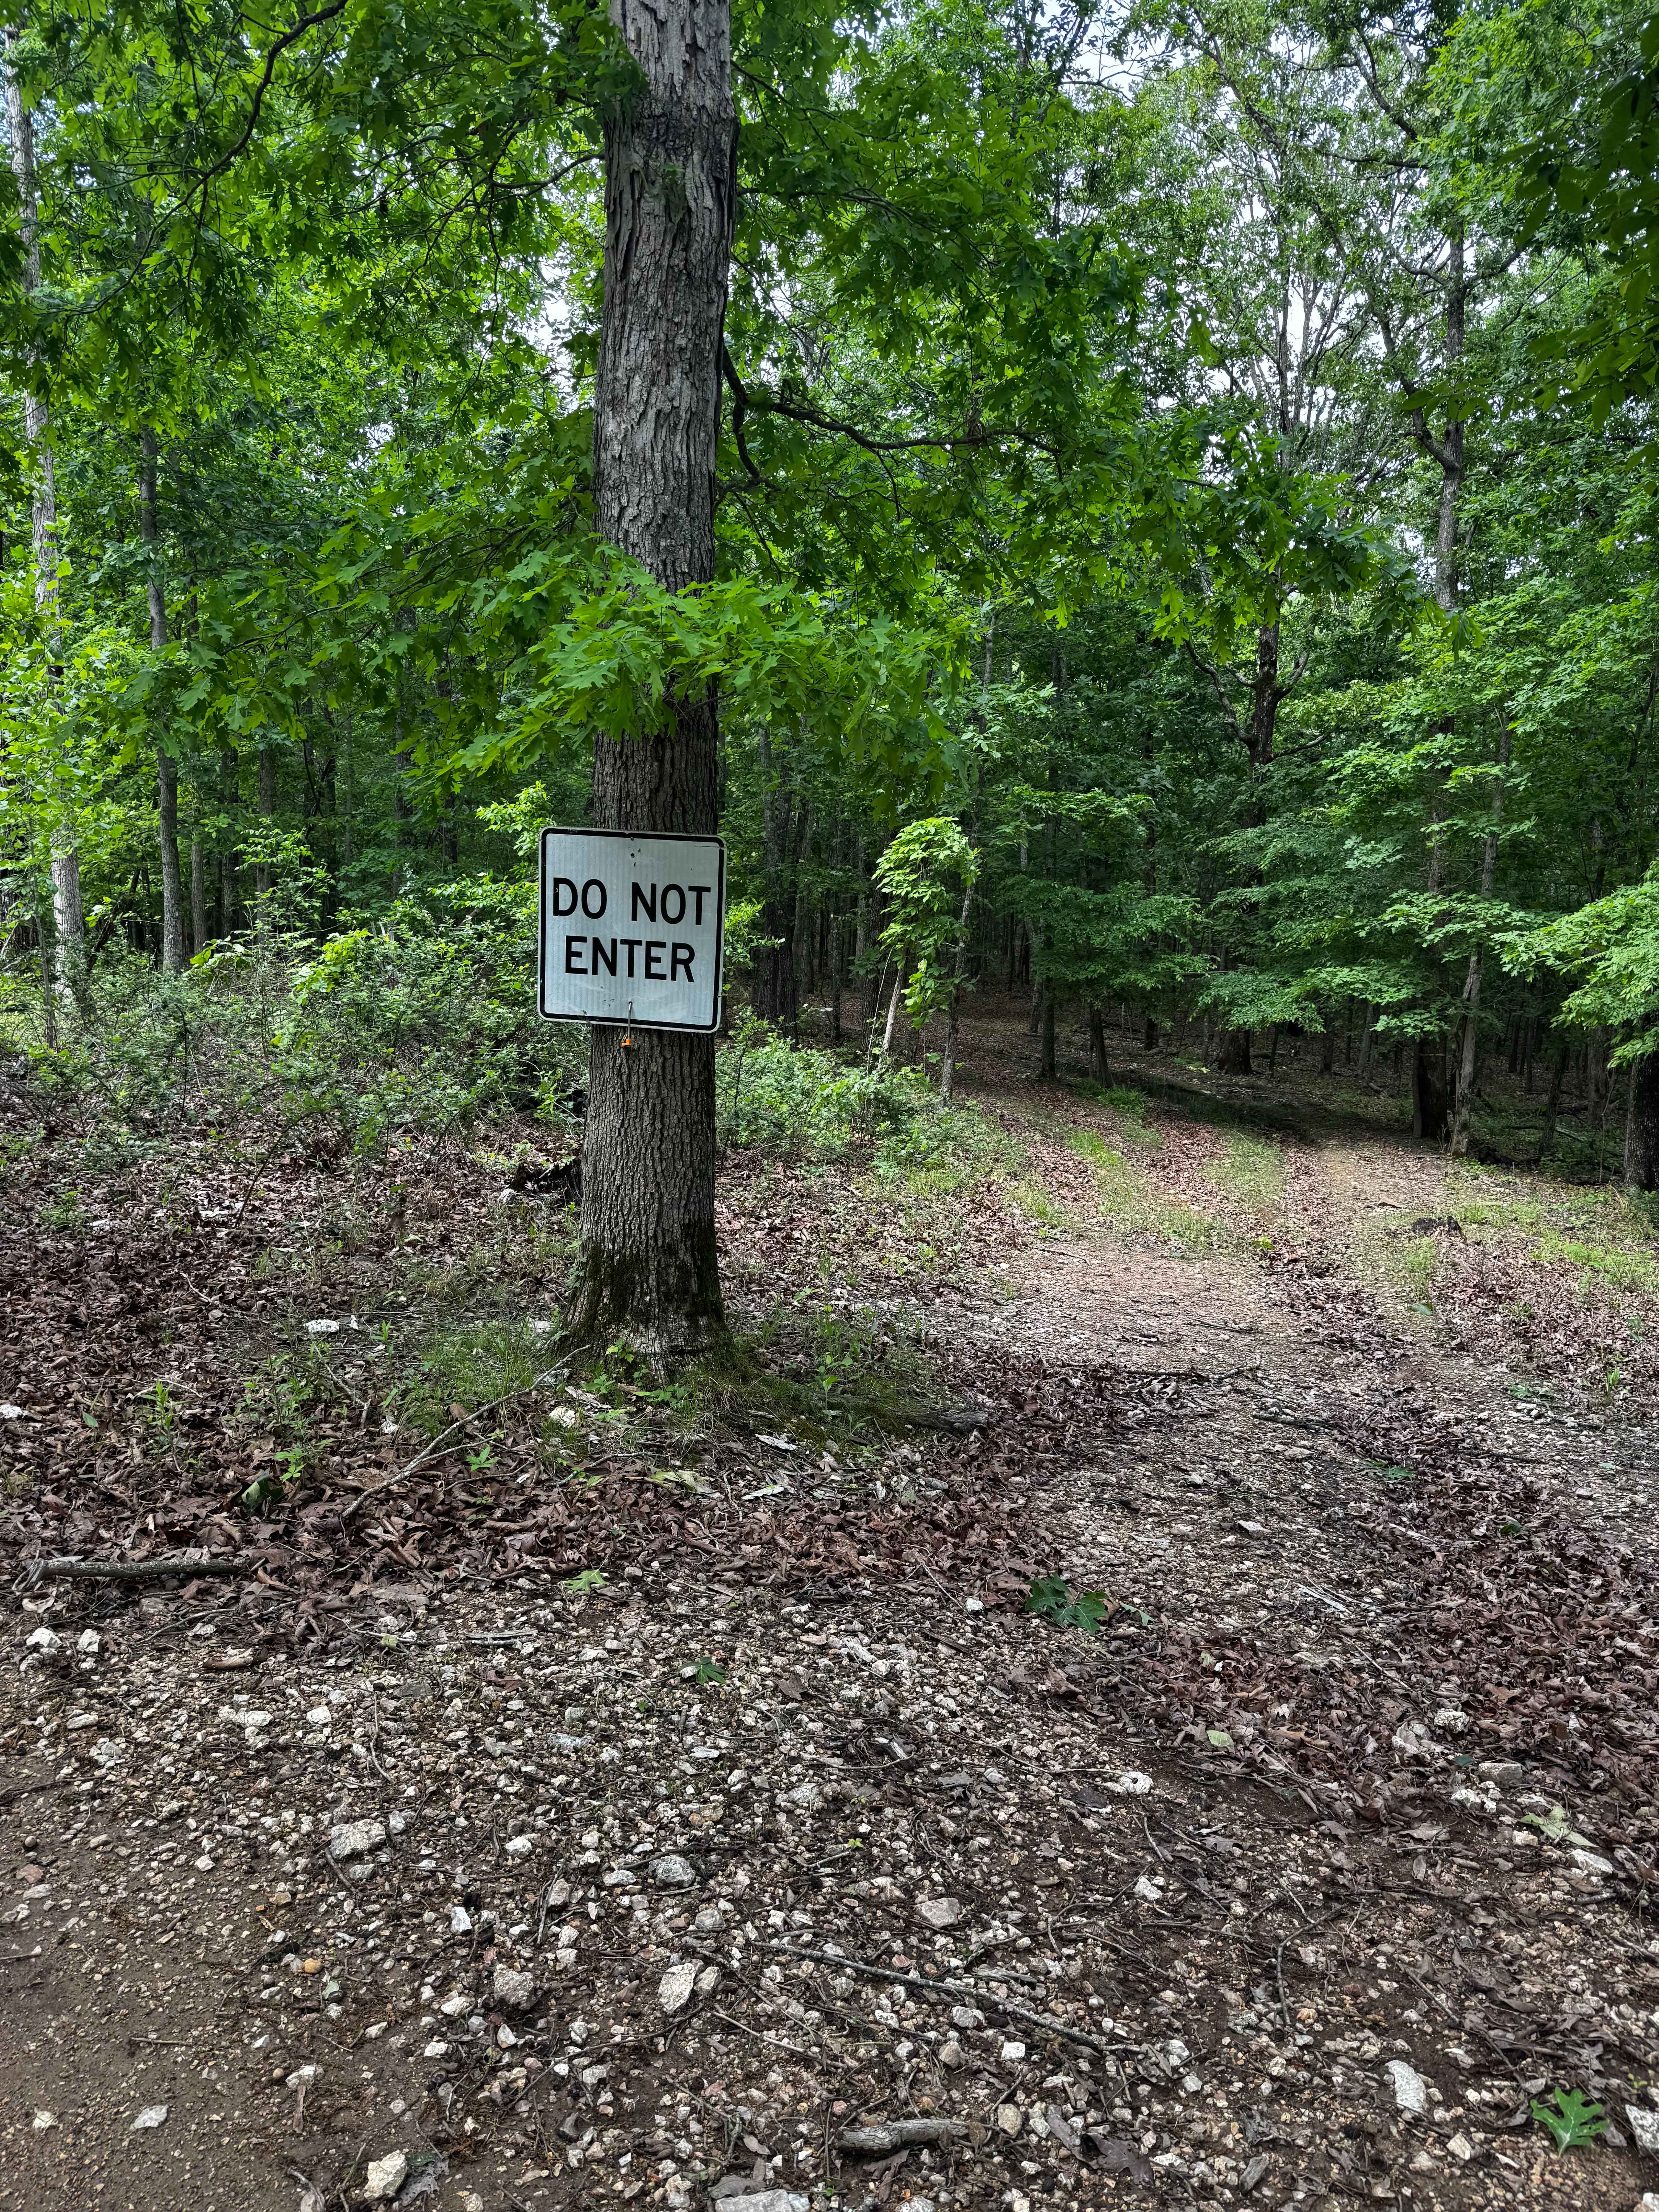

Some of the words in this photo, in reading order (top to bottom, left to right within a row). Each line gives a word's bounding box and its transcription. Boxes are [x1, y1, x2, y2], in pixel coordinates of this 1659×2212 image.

[553, 877, 607, 919] DO
[631, 882, 711, 926] NOT
[565, 935, 695, 983] ENTER
